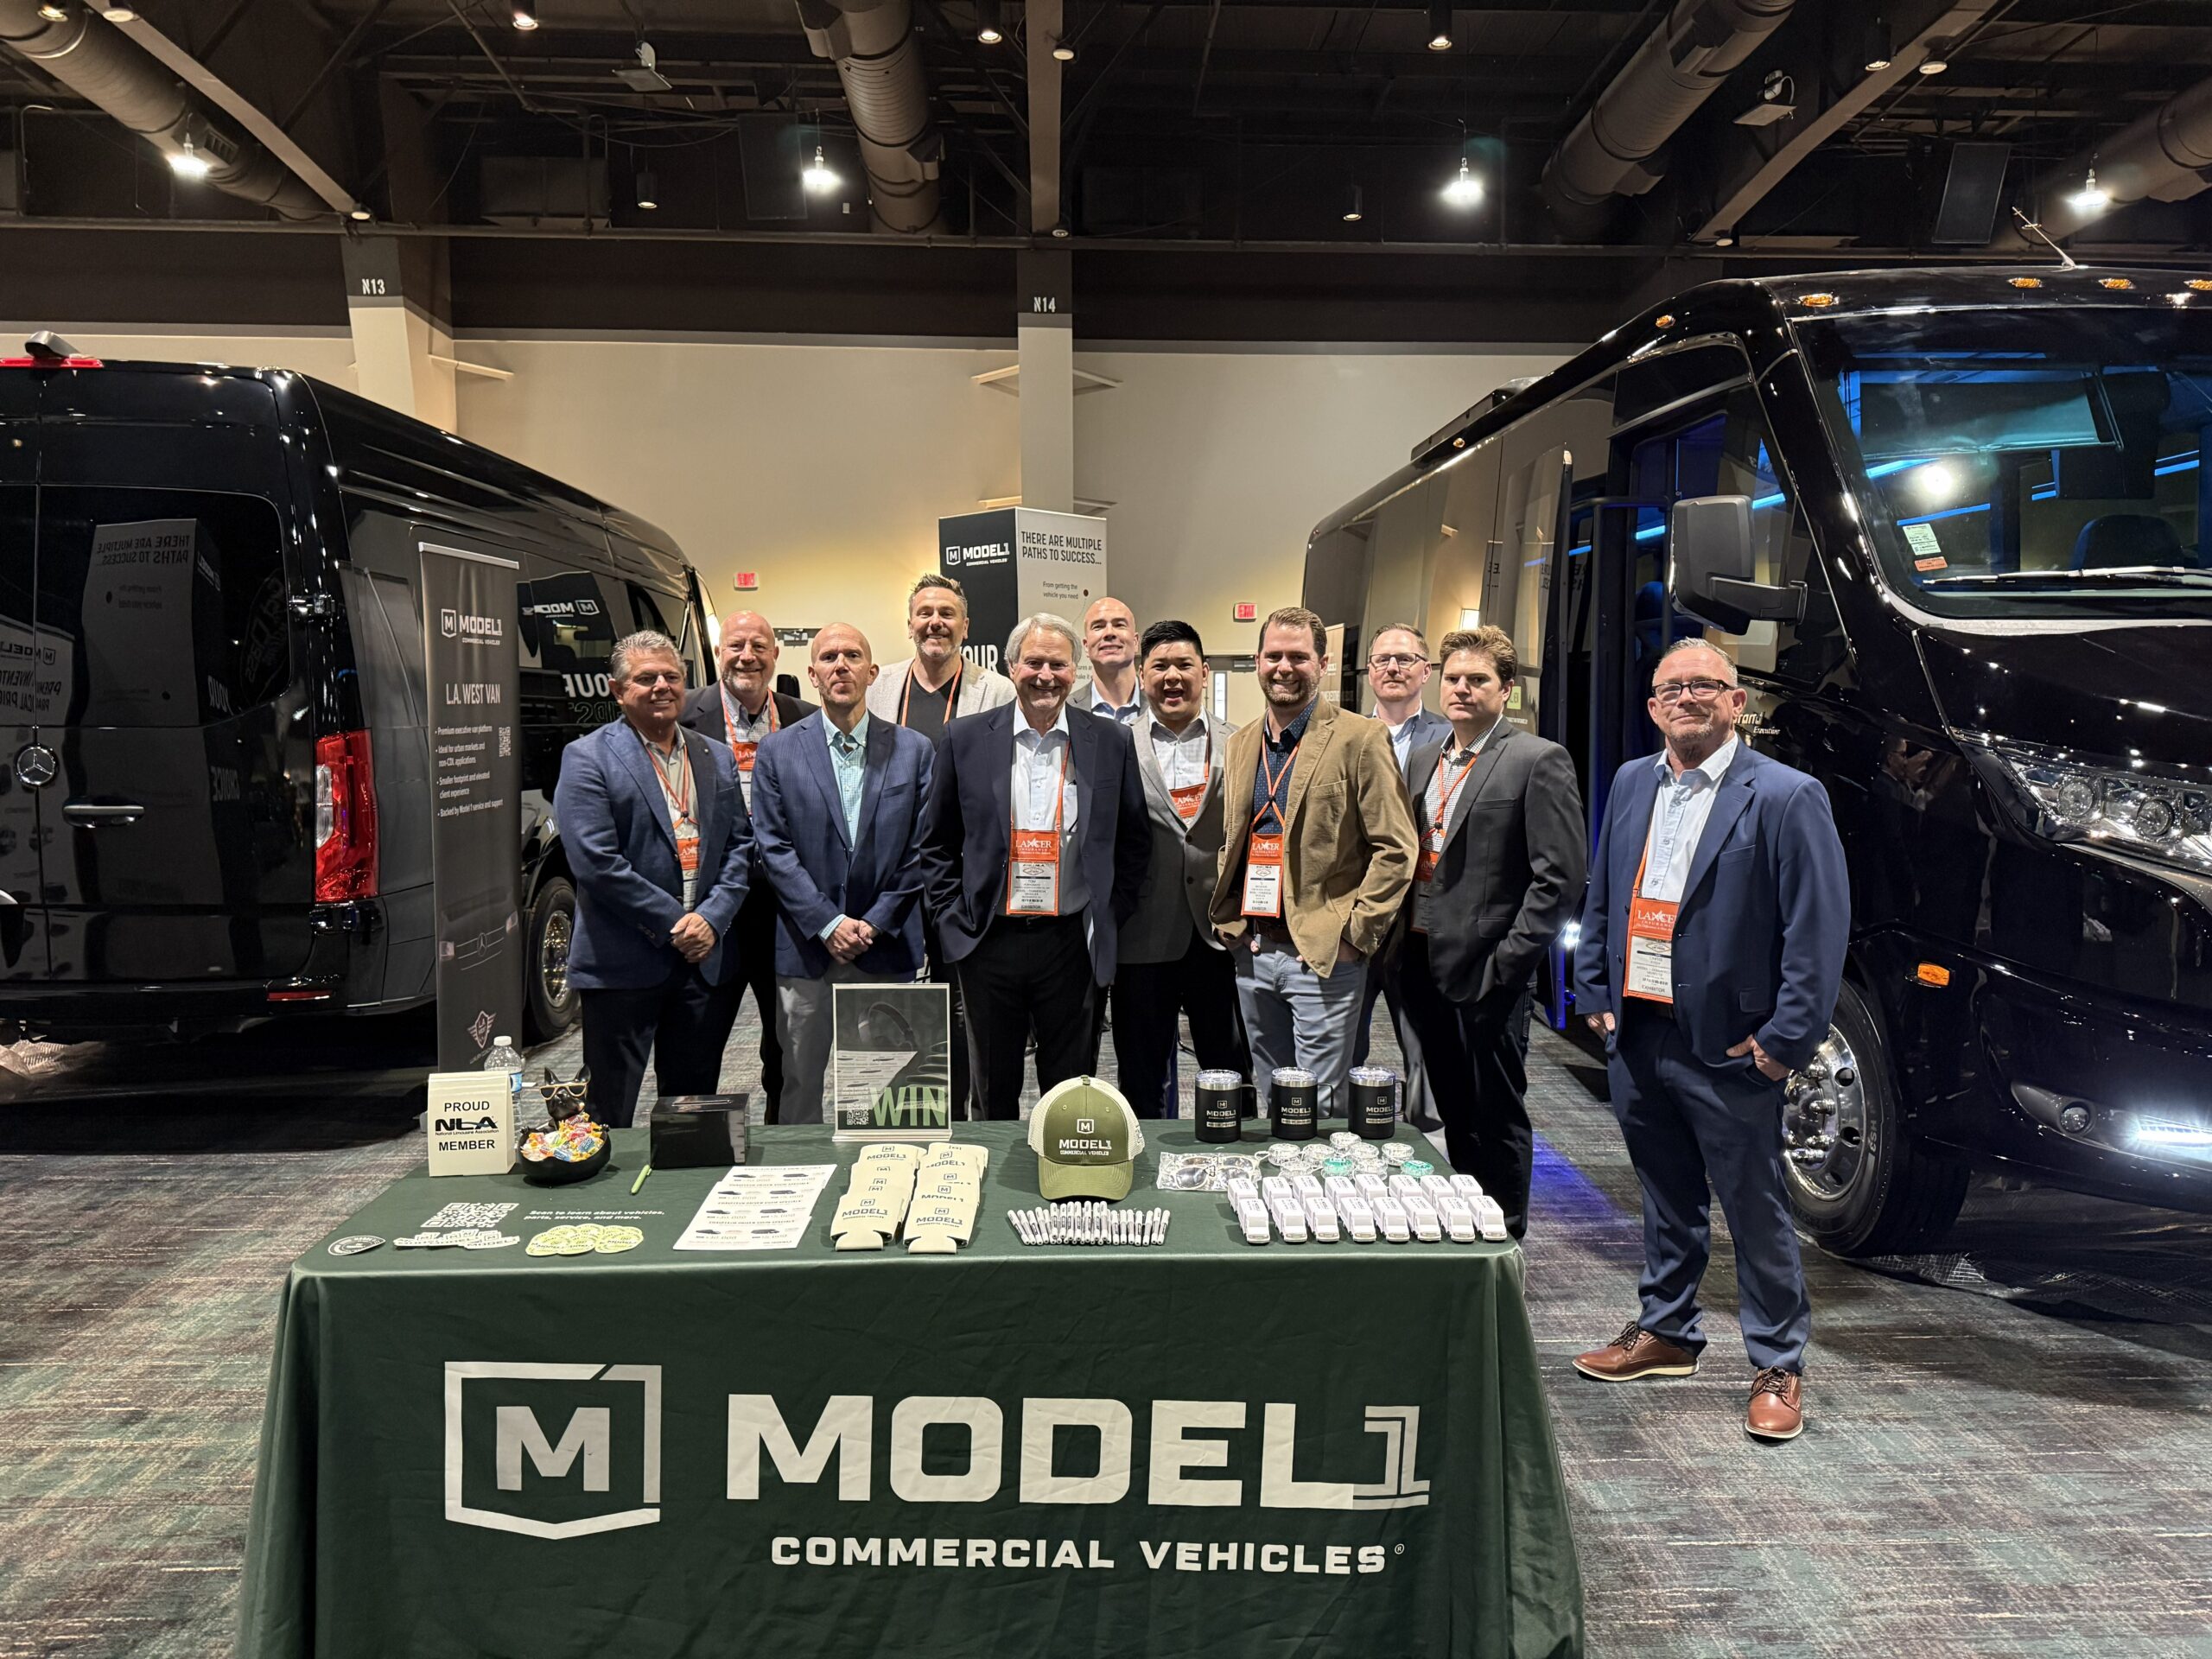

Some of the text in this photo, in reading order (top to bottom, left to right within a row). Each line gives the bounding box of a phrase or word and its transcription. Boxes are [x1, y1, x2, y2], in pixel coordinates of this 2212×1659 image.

[361, 278, 385, 295] N13
[1034, 296, 1056, 312] N14
[1021, 531, 1103, 550] THERE ARE MULTIPLE
[1022, 546, 1047, 560] PATHS
[1049, 549, 1059, 561] TO
[960, 644, 999, 673] OUR
[446, 683, 500, 704] L.A. WEST VAN
[1637, 909, 1676, 924] LANCE
[444, 1101, 490, 1112] PROUD
[870, 1086, 946, 1127] WIN
[435, 1116, 498, 1131] NLA
[439, 1140, 495, 1151] MEMBER
[772, 1536, 1115, 1568] COMMERCIAL
